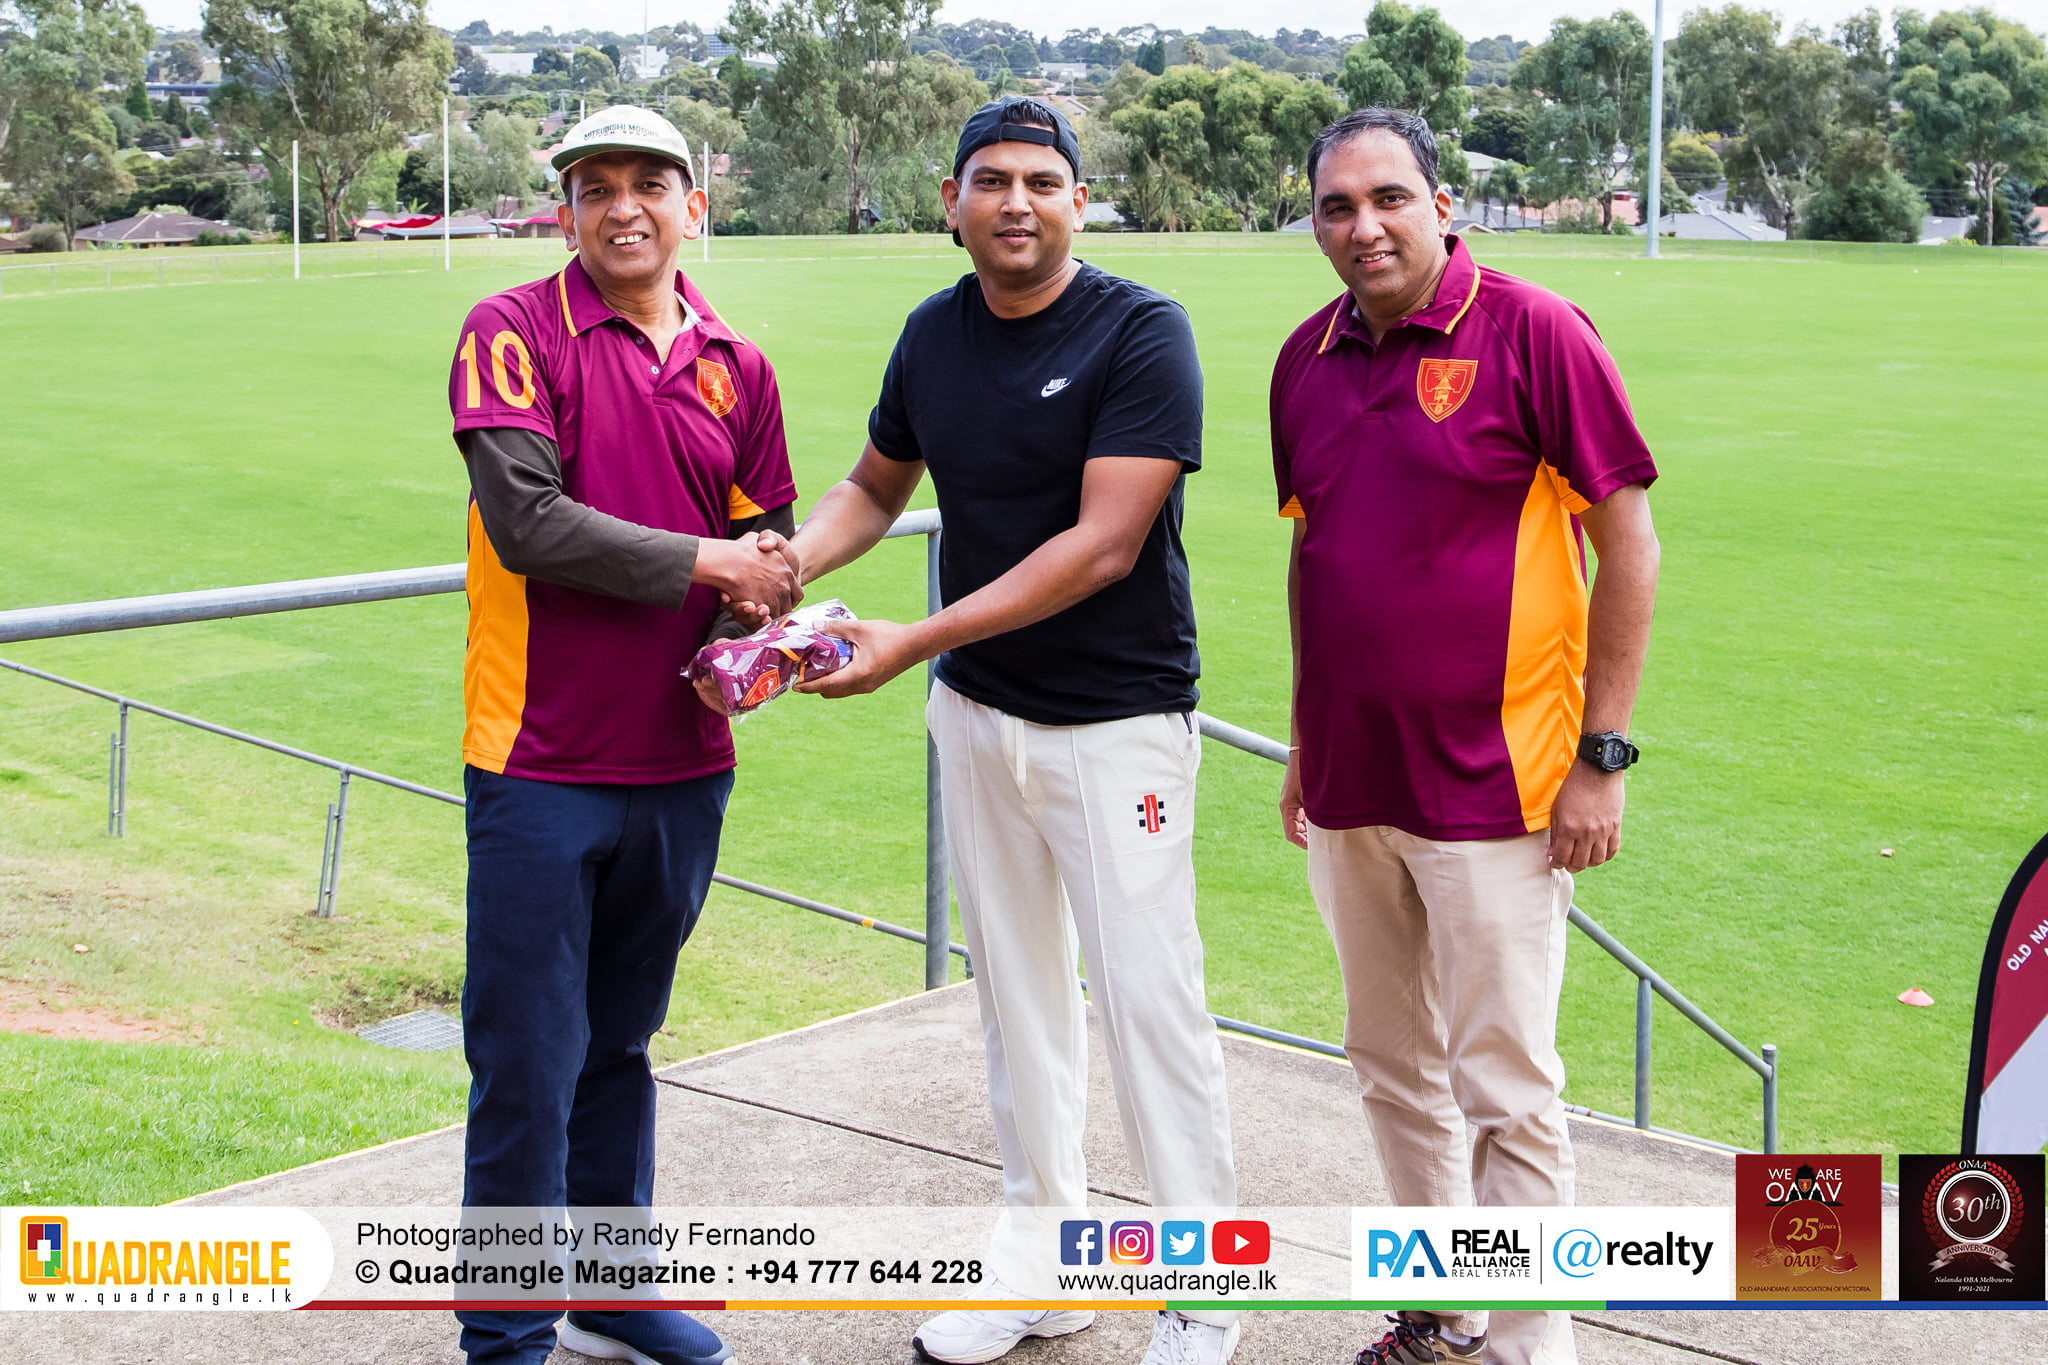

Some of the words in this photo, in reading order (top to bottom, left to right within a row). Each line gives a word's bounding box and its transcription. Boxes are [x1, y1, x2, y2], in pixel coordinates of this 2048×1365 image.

[459, 330, 536, 409] 10
[2006, 943, 2032, 971] OLD
[2029, 919, 2048, 945] NA
